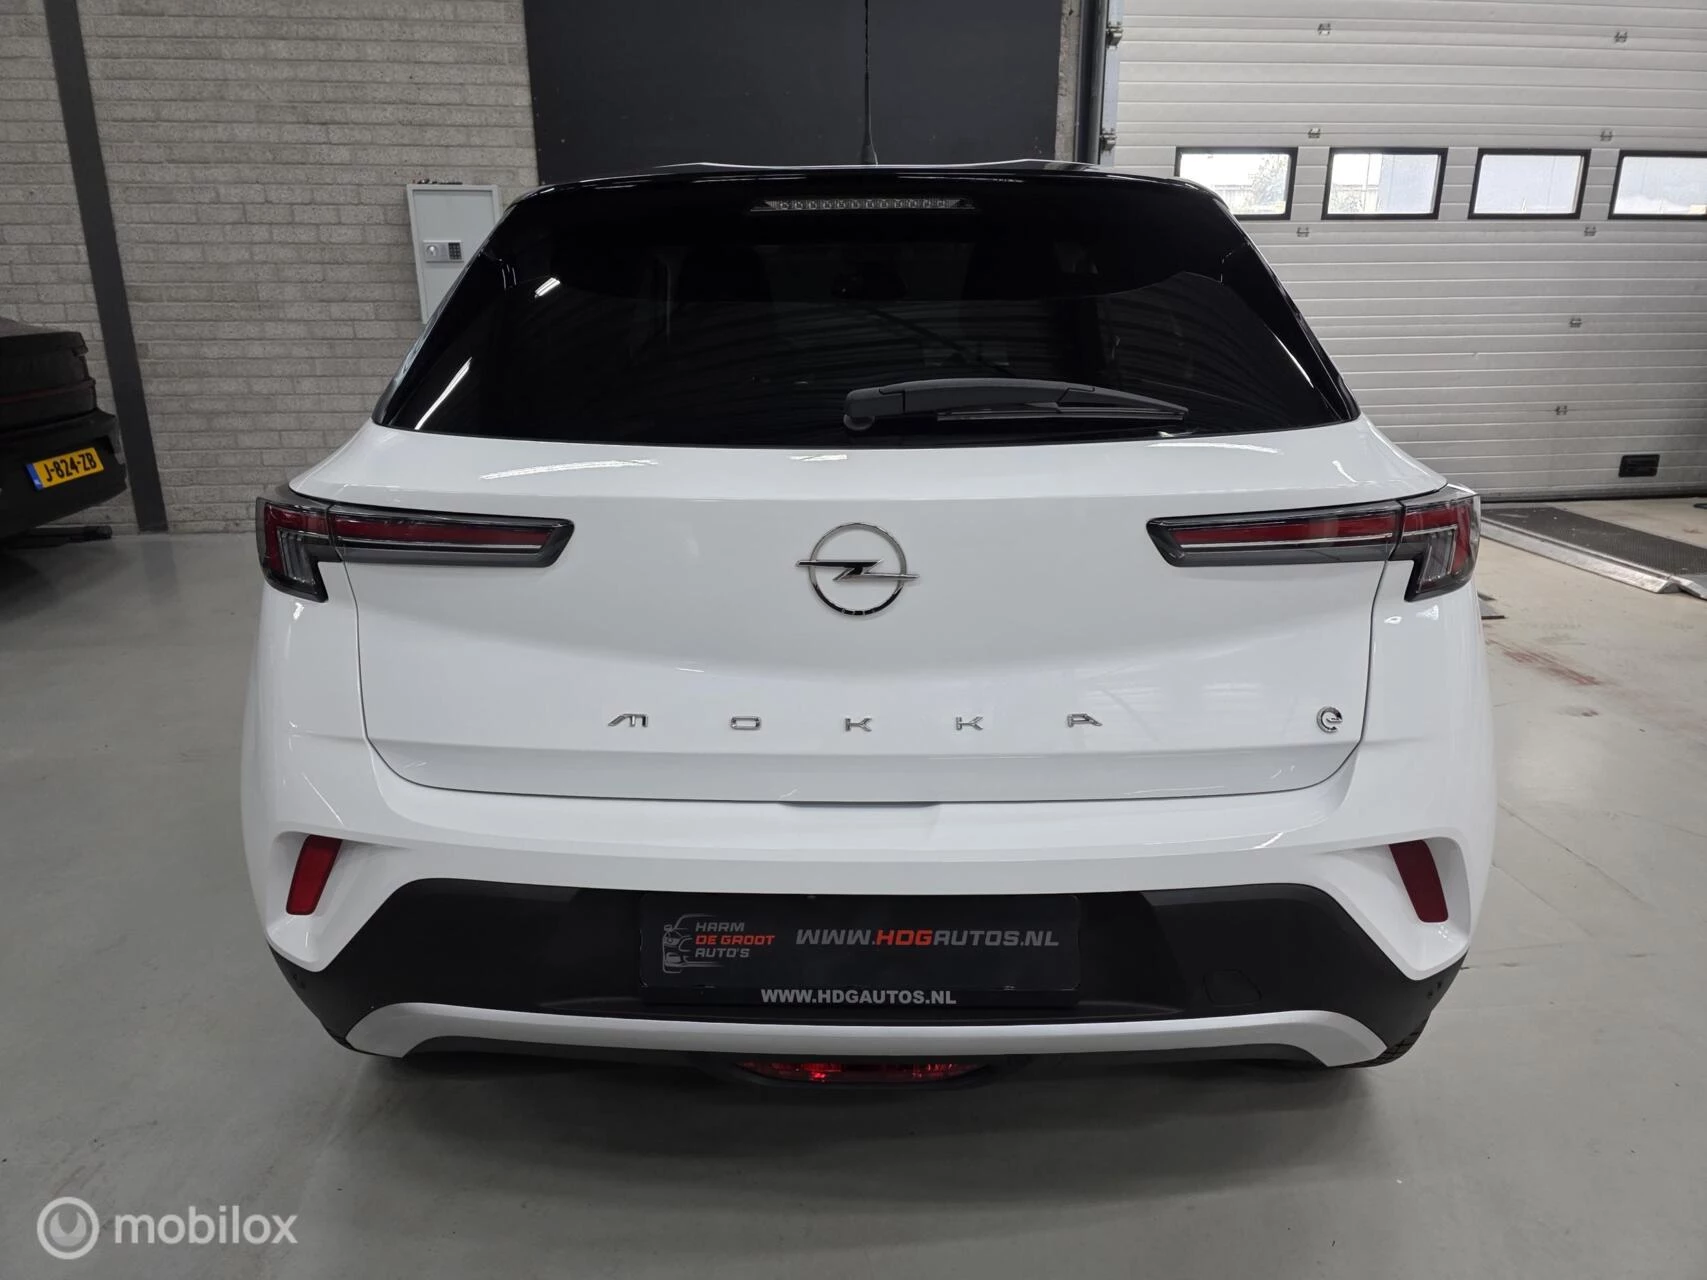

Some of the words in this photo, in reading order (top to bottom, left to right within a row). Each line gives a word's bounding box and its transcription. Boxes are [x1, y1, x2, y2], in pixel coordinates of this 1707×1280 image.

[44, 453, 97, 482] J-824-ZB
[695, 921, 745, 932] HARM
[696, 935, 716, 945] DE
[720, 935, 775, 946] GROOT
[795, 929, 1060, 946] WWW.HDGAUTOS.NL
[694, 948, 750, 958] AUTO'S
[760, 989, 957, 1005] WWW.HDGAUTOS.NL
